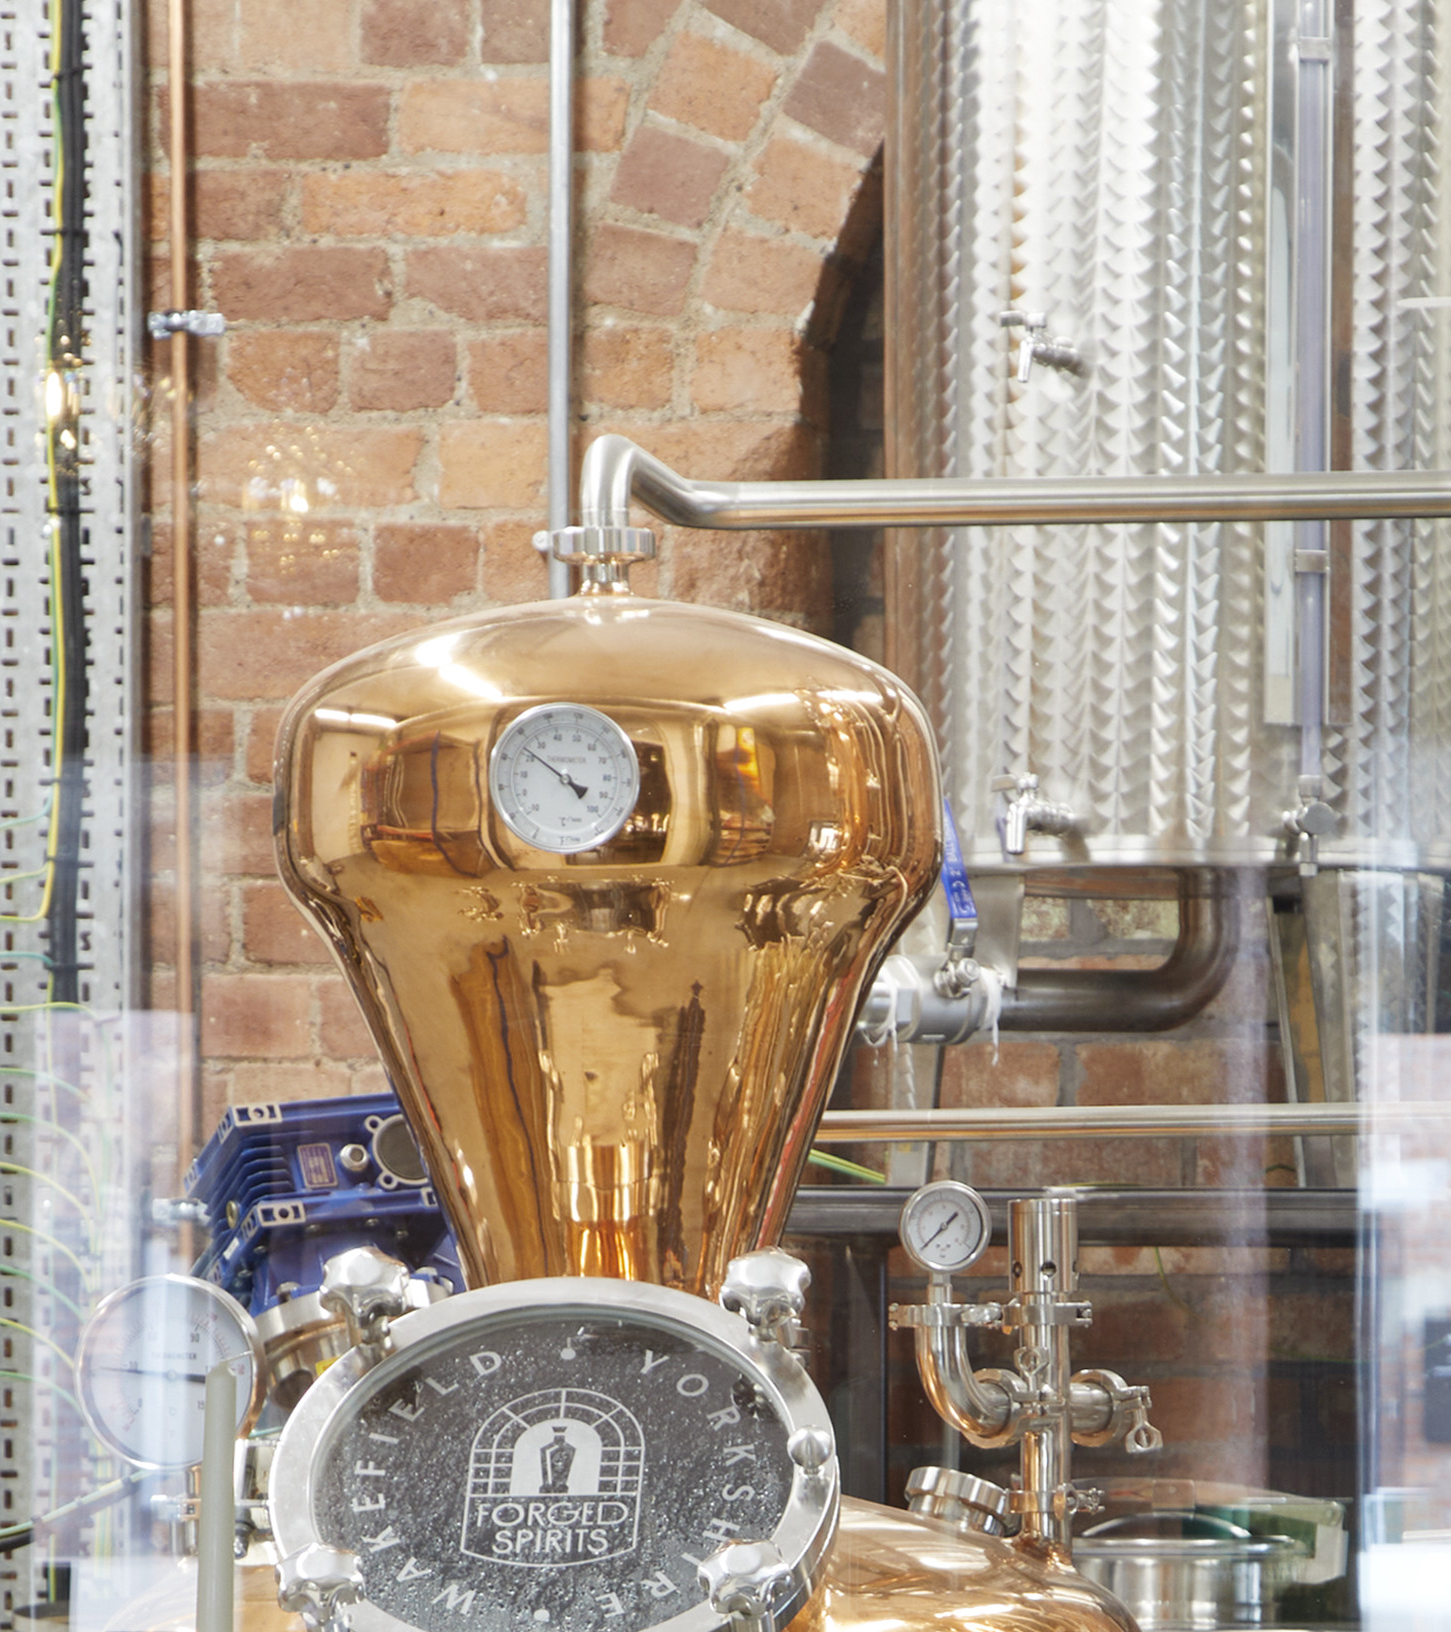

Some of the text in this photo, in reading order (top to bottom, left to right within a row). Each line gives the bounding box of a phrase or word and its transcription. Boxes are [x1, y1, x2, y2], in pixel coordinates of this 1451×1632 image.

[353, 1350, 502, 1615] WAKEFIELD
[476, 1501, 628, 1527] FORGED
[491, 1528, 609, 1555] SPIRITS
